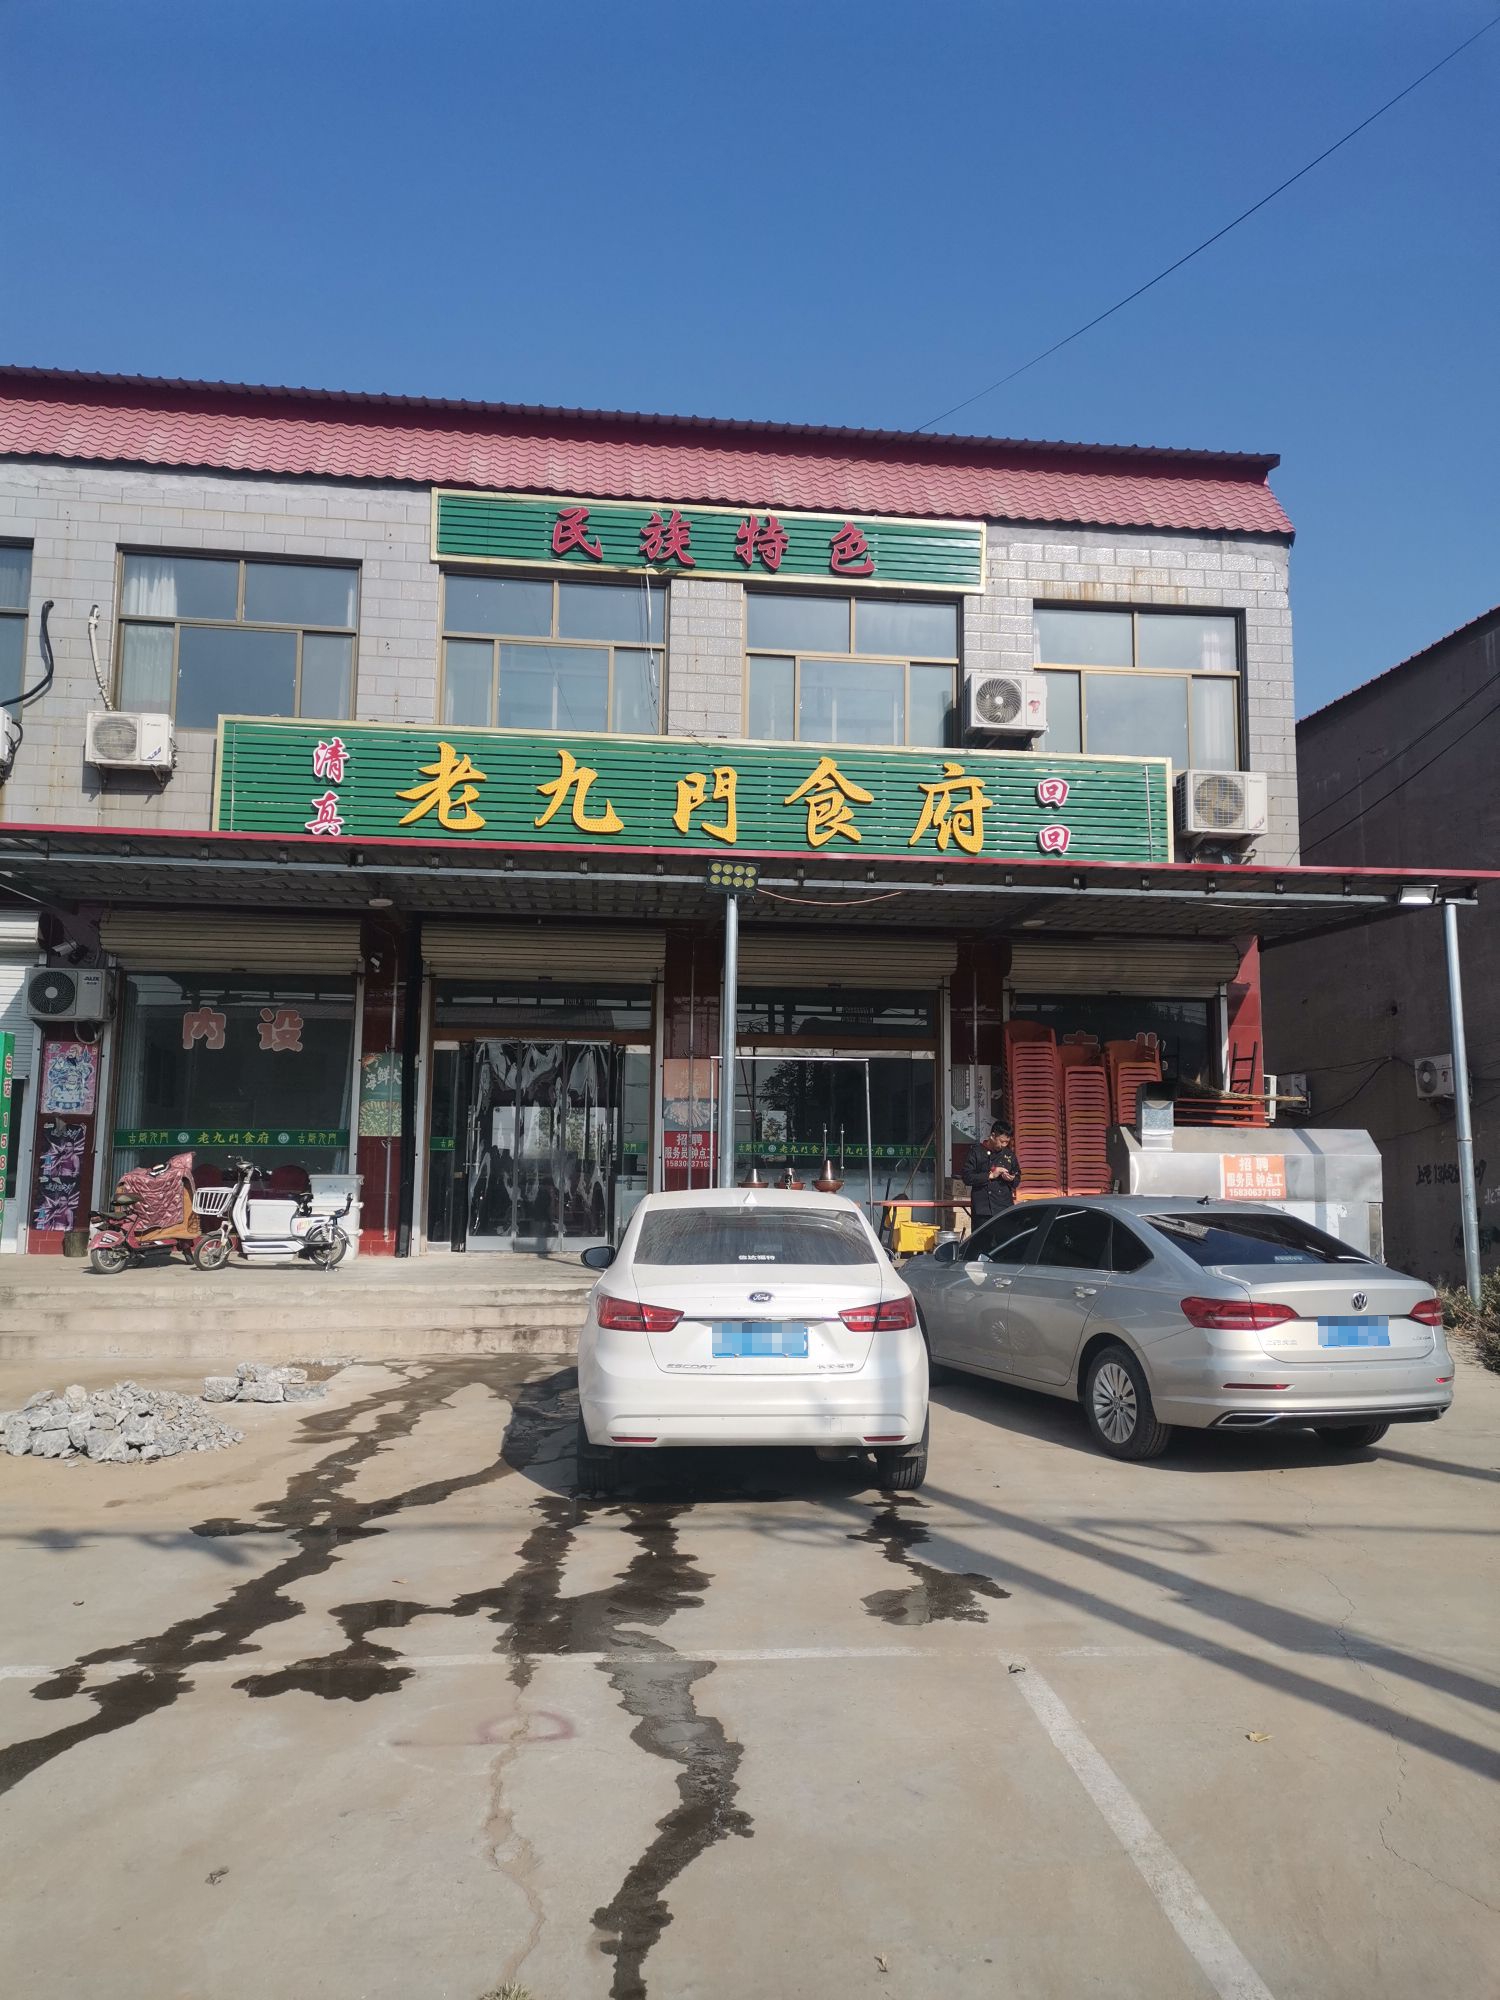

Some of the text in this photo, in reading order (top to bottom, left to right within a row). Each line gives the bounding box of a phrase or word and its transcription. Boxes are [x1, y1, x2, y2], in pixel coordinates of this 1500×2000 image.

[550, 506, 873, 578] 民族特色
[306, 736, 350, 836] 清真
[395, 741, 994, 855] 老九門食府
[183, 1007, 303, 1052] 内设
[676, 1133, 703, 1146] 招聘
[666, 1160, 710, 1168] 158303716
[1239, 1156, 1269, 1172] 招聘
[1226, 1172, 1284, 1187] 服务员 钟点工
